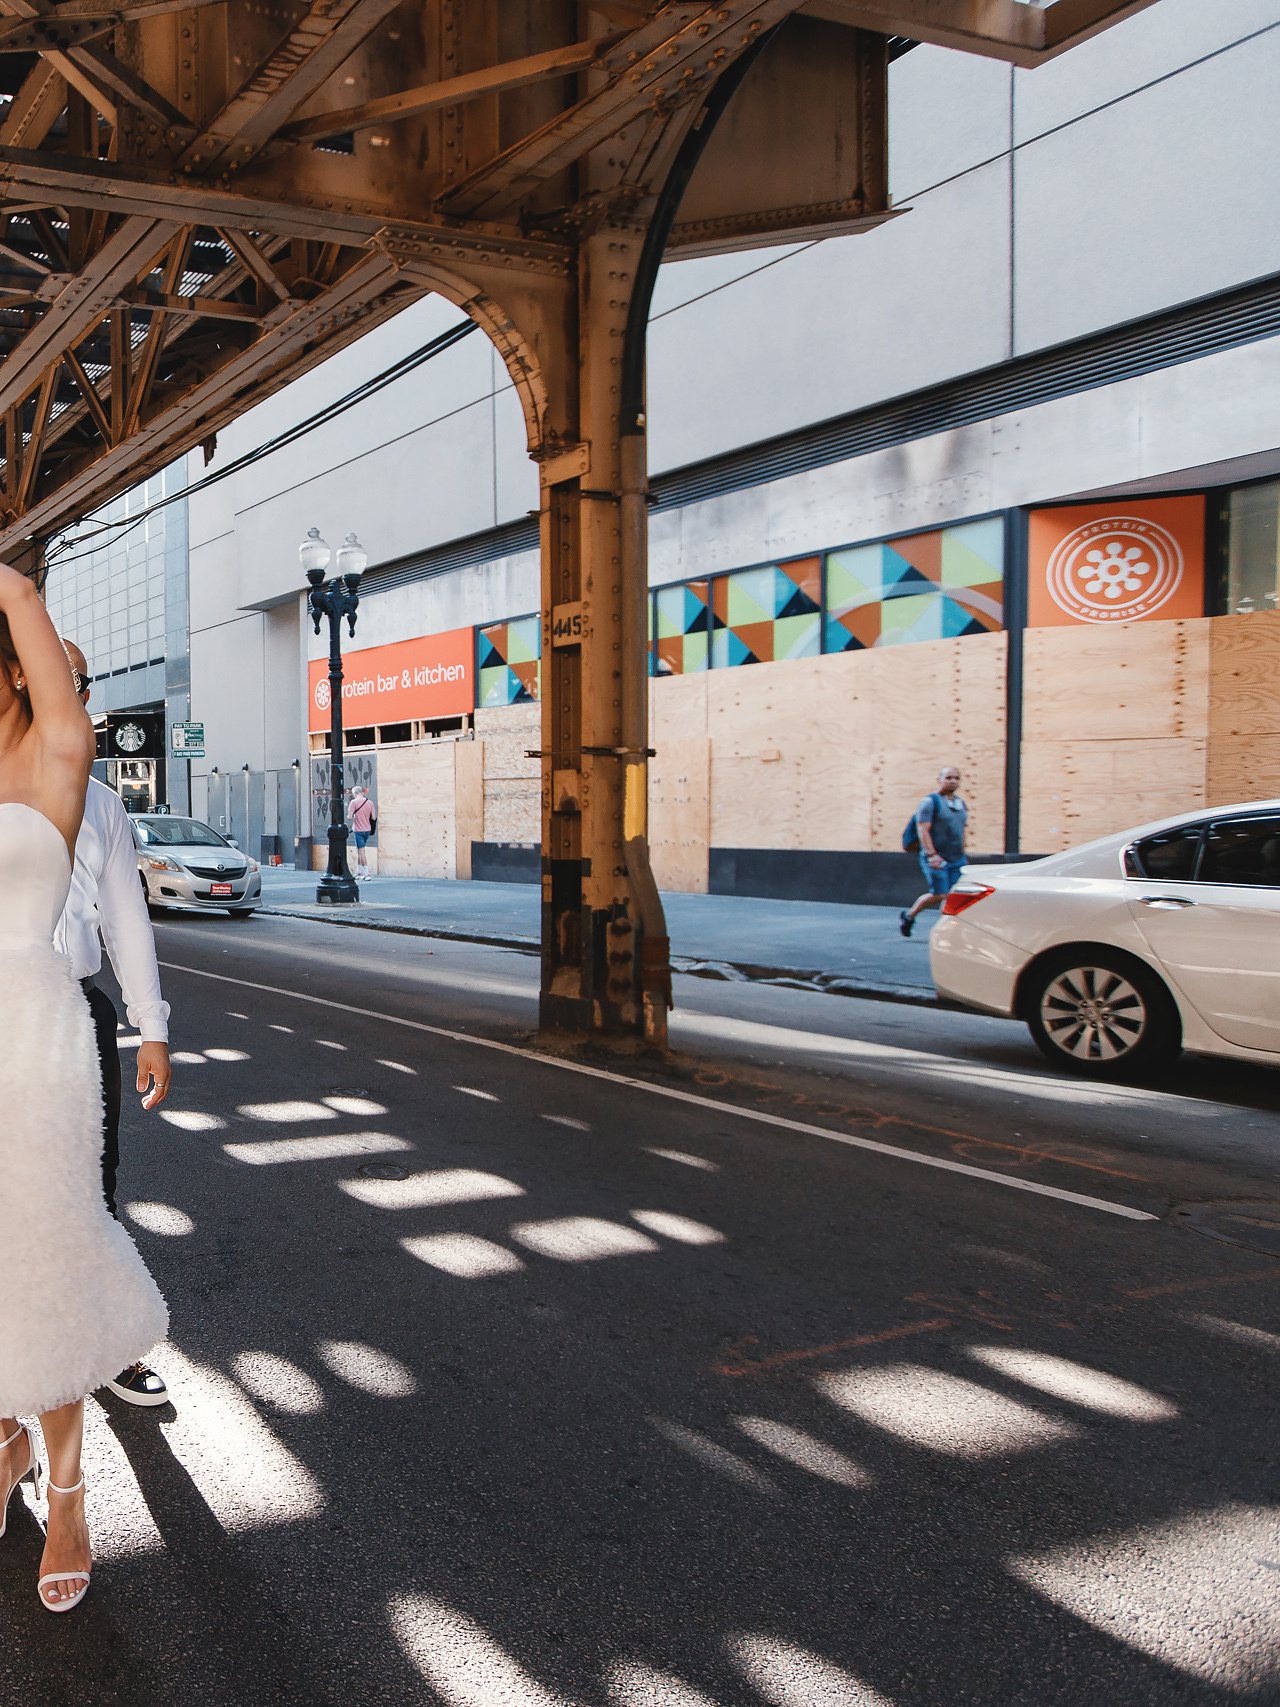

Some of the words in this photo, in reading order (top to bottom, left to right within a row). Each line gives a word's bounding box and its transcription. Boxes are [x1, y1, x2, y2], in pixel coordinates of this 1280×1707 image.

[1081, 522, 1147, 537] PROTEIN
[1080, 603, 1146, 618] PROMISE
[553, 615, 581, 638] 445
[341, 677, 375, 698] rotein
[377, 674, 399, 692] bar
[401, 669, 411, 688] &
[414, 663, 465, 686] kitchen
